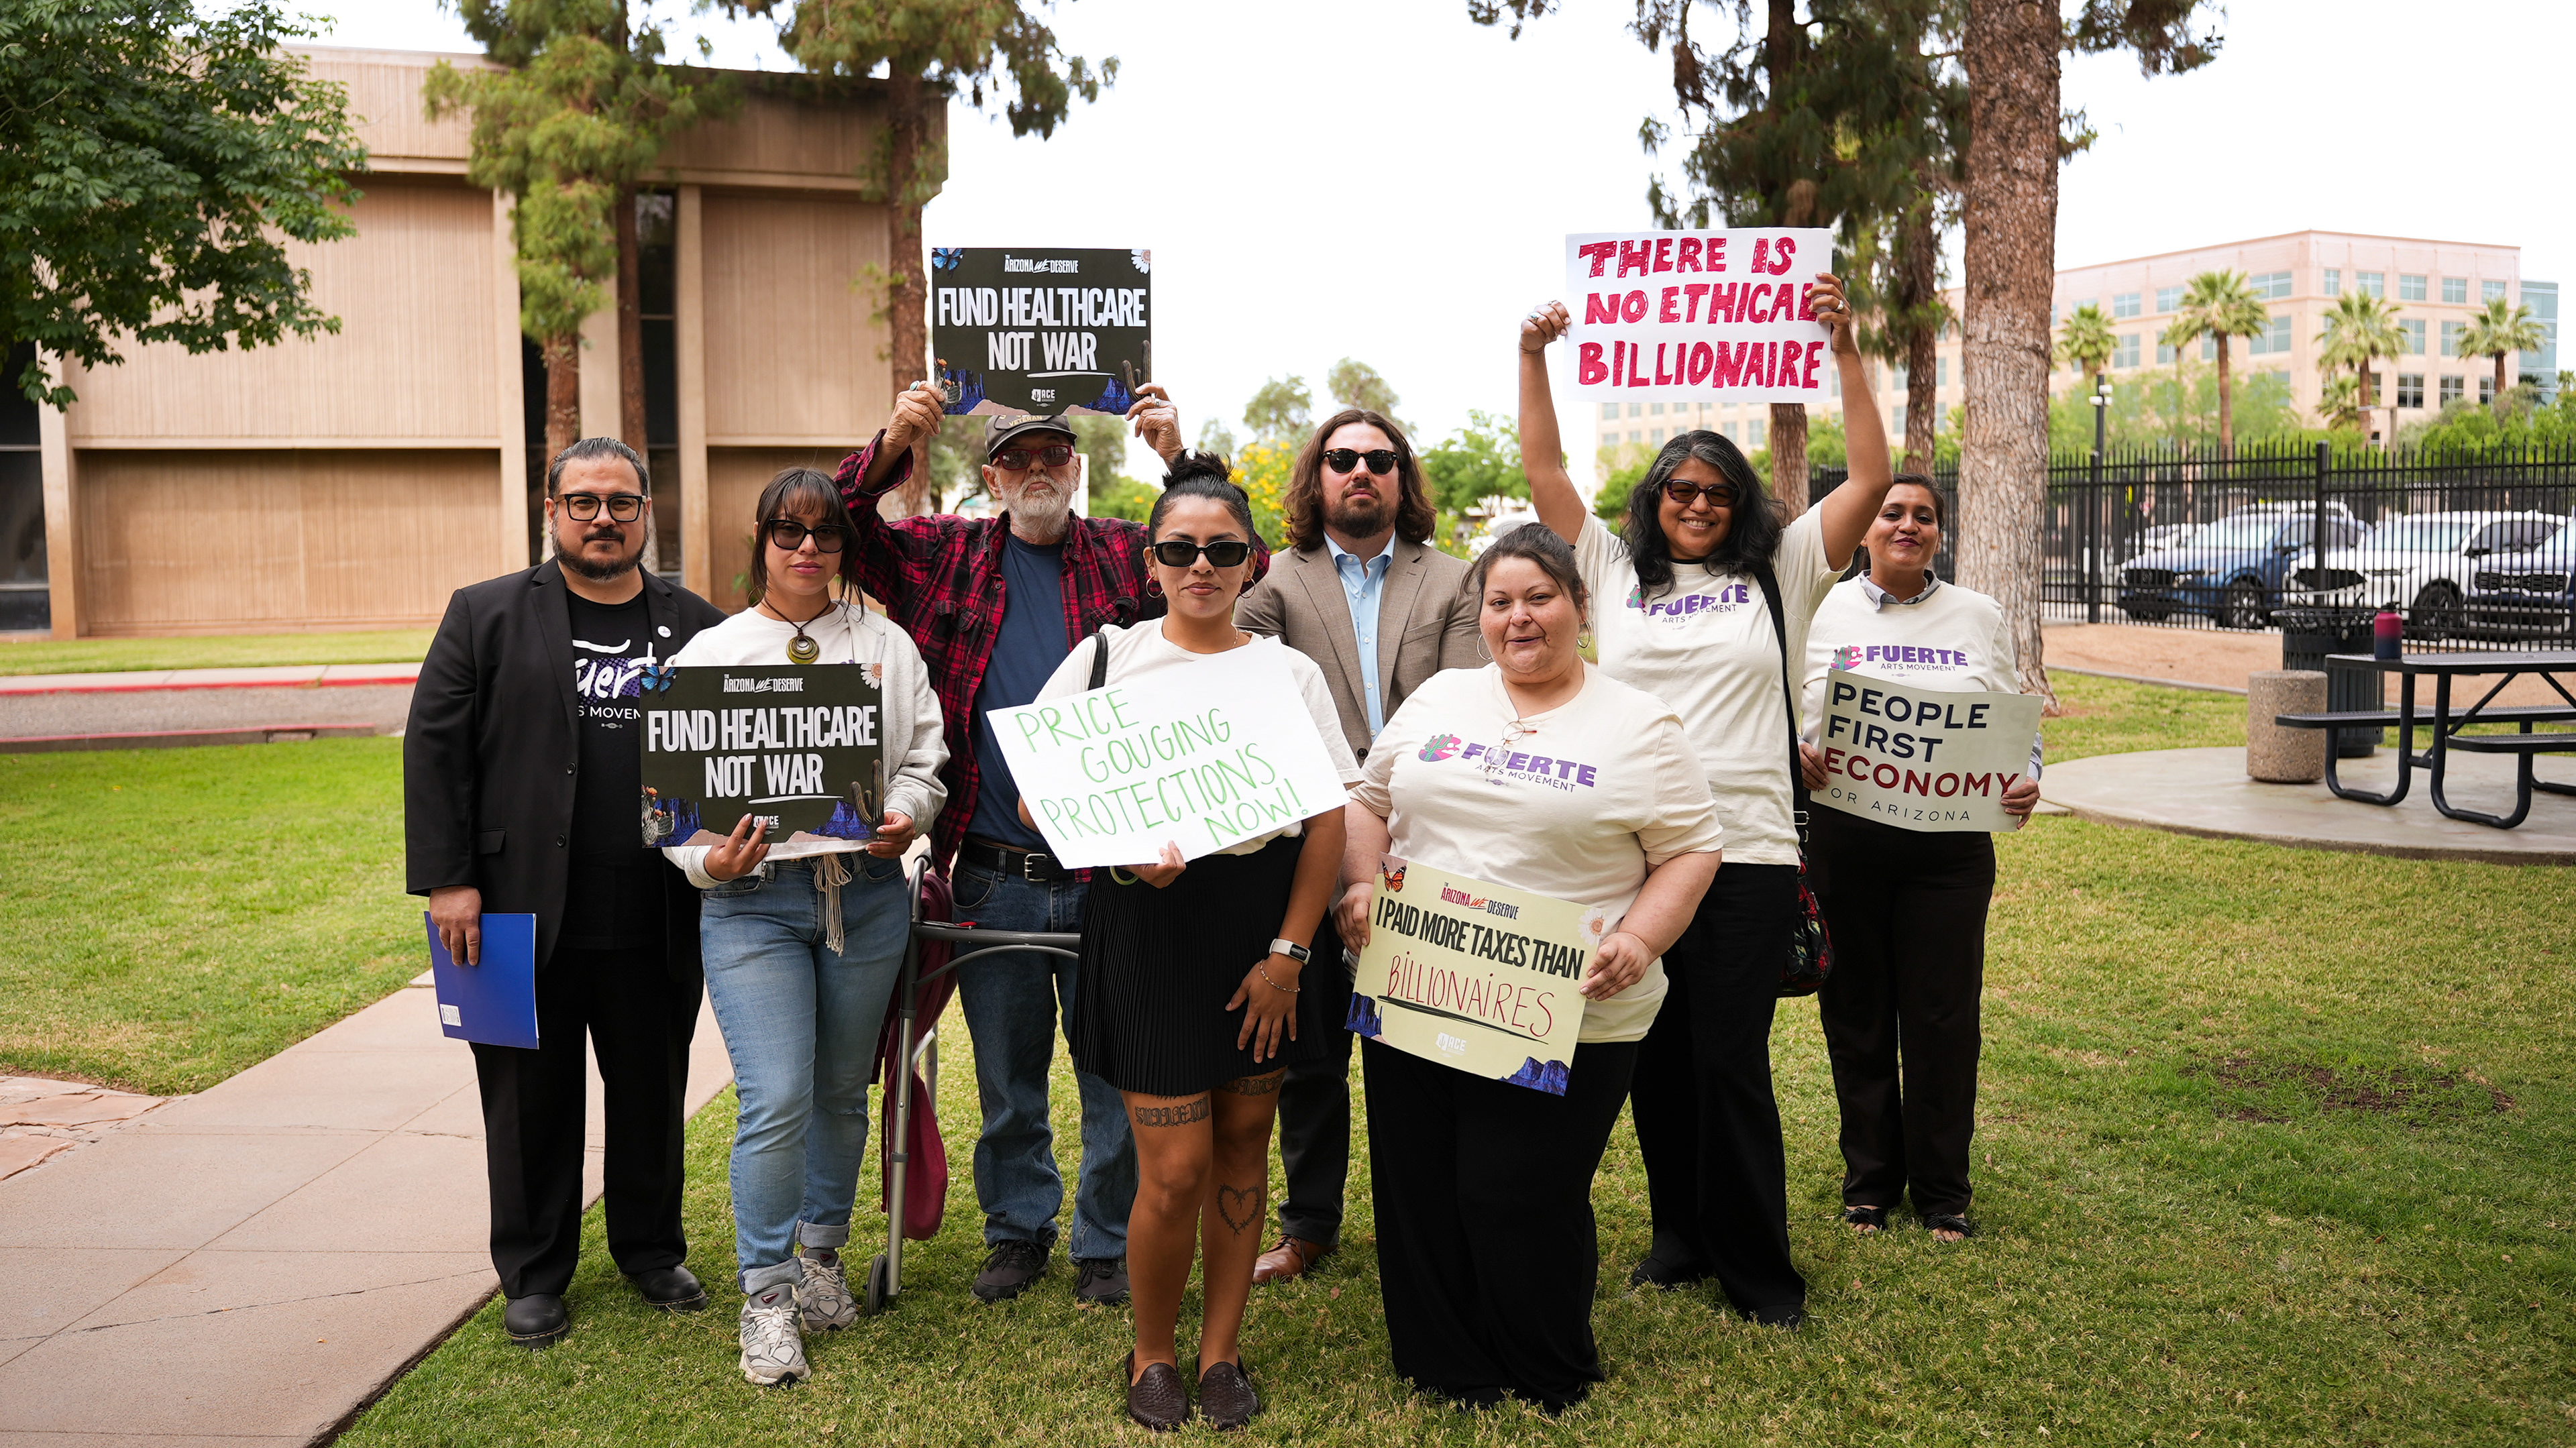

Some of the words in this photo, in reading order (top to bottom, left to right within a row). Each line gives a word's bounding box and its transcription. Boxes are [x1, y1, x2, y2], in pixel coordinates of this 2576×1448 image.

[1004, 259, 1033, 272] ARIZONA
[1033, 258, 1051, 273] WE
[1050, 260, 1079, 273] DESERVE
[1578, 237, 1727, 278] THERE
[1752, 237, 1796, 276] IS
[938, 288, 998, 327] FUND
[1002, 288, 1146, 327] HEALTHCARE
[1585, 290, 1648, 325] NO
[1659, 282, 1818, 324] ETHICAL
[988, 331, 1034, 371] NOT
[1041, 332, 1097, 370] WAR
[1578, 341, 1825, 389] BILLIONAIRE
[1041, 389, 1055, 398] ACE
[1009, 415, 1043, 427] VETERAN
[1649, 584, 1750, 616] FUERTE
[1688, 604, 1737, 620] MOVEMENT
[1866, 645, 1968, 667] FUERTE
[1907, 663, 1956, 671] MOVEMENT
[723, 678, 755, 692] ARIZONA
[754, 677, 773, 693] WE
[773, 677, 804, 692] DESERVE
[1832, 681, 1990, 729] PEOPLE
[647, 710, 716, 752] FUND
[720, 705, 877, 750] HEALTHCARE
[1015, 689, 1139, 753] PRICE
[1827, 714, 1943, 763] FIRST
[1081, 708, 1231, 783] GOUGING
[1461, 742, 1597, 788] FUERTE
[705, 755, 756, 798] NOT
[763, 753, 824, 795] WAR
[1040, 743, 1276, 841] PROTECTIONS
[1507, 771, 1576, 793] MOVEMENT
[1824, 746, 2020, 798] ECONOMY
[1204, 778, 1310, 846] NOW!
[1817, 787, 1857, 804] OR
[1871, 800, 1970, 822] ARIZONA
[1440, 887, 1471, 907] ARIZONA
[1468, 897, 1489, 909] WE
[1487, 899, 1519, 920] DESERVE
[1375, 897, 1385, 926] I
[1383, 901, 1420, 938] PAID
[1418, 910, 1472, 953] MORE
[1470, 924, 1530, 968] TAXES
[1531, 939, 1585, 981] THAN
